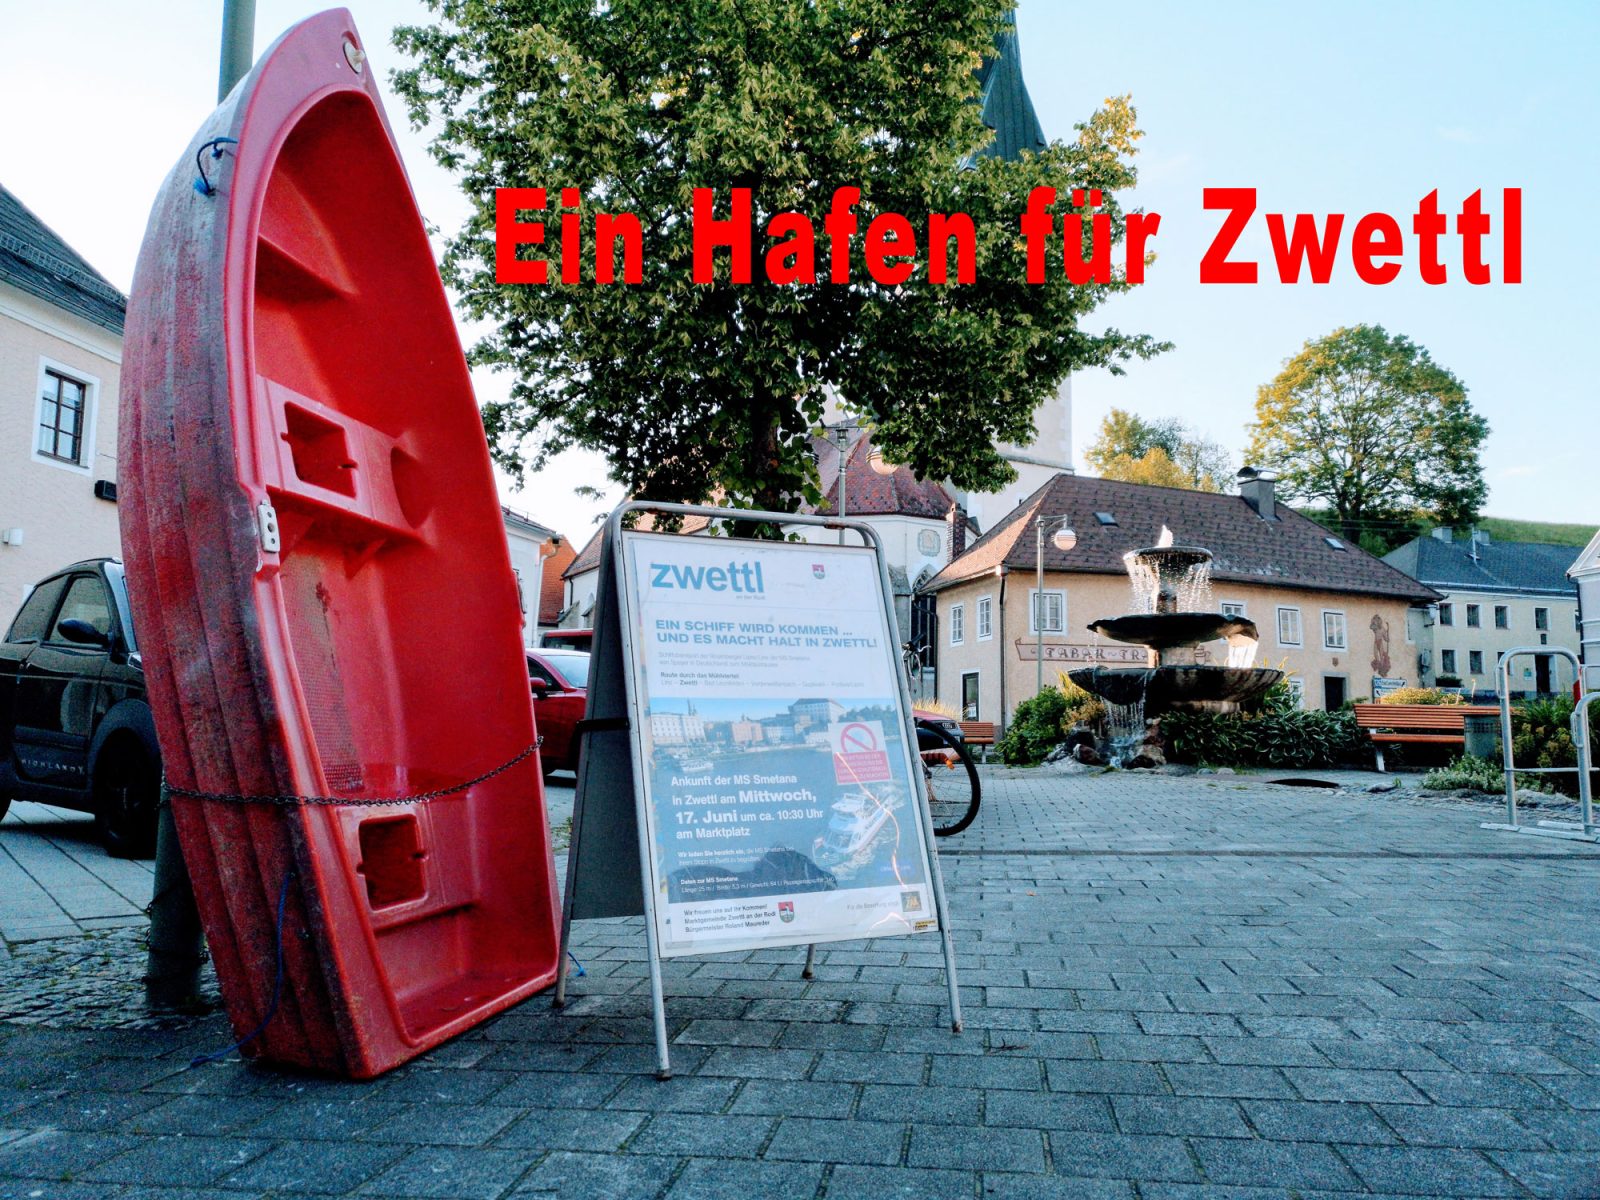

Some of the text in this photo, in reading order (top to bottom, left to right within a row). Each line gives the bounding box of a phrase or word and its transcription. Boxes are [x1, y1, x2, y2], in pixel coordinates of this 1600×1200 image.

[650, 560, 765, 593] zwettl
[655, 619, 680, 631] EIN
[684, 620, 735, 632] SCHIFF
[738, 622, 775, 634] WIRD
[778, 624, 839, 636] KOMMEN
[657, 632, 878, 649] UND ES MACHT HALT IN ZWETTL!
[1045, 647, 1106, 661] TABAK
[679, 671, 696, 679] durch
[697, 672, 708, 680] das
[679, 679, 698, 687] Zwettl
[671, 774, 798, 787] Ankunft der MS Smetana
[672, 788, 817, 806] in Zwettl am Mittwoch,
[676, 808, 823, 824] 17. Juni um ca. 10:30 Uhr
[676, 827, 751, 840] am Marktplatz
[684, 916, 727, 925] Marktgemeinde
[685, 924, 724, 933] Bürgermeister
